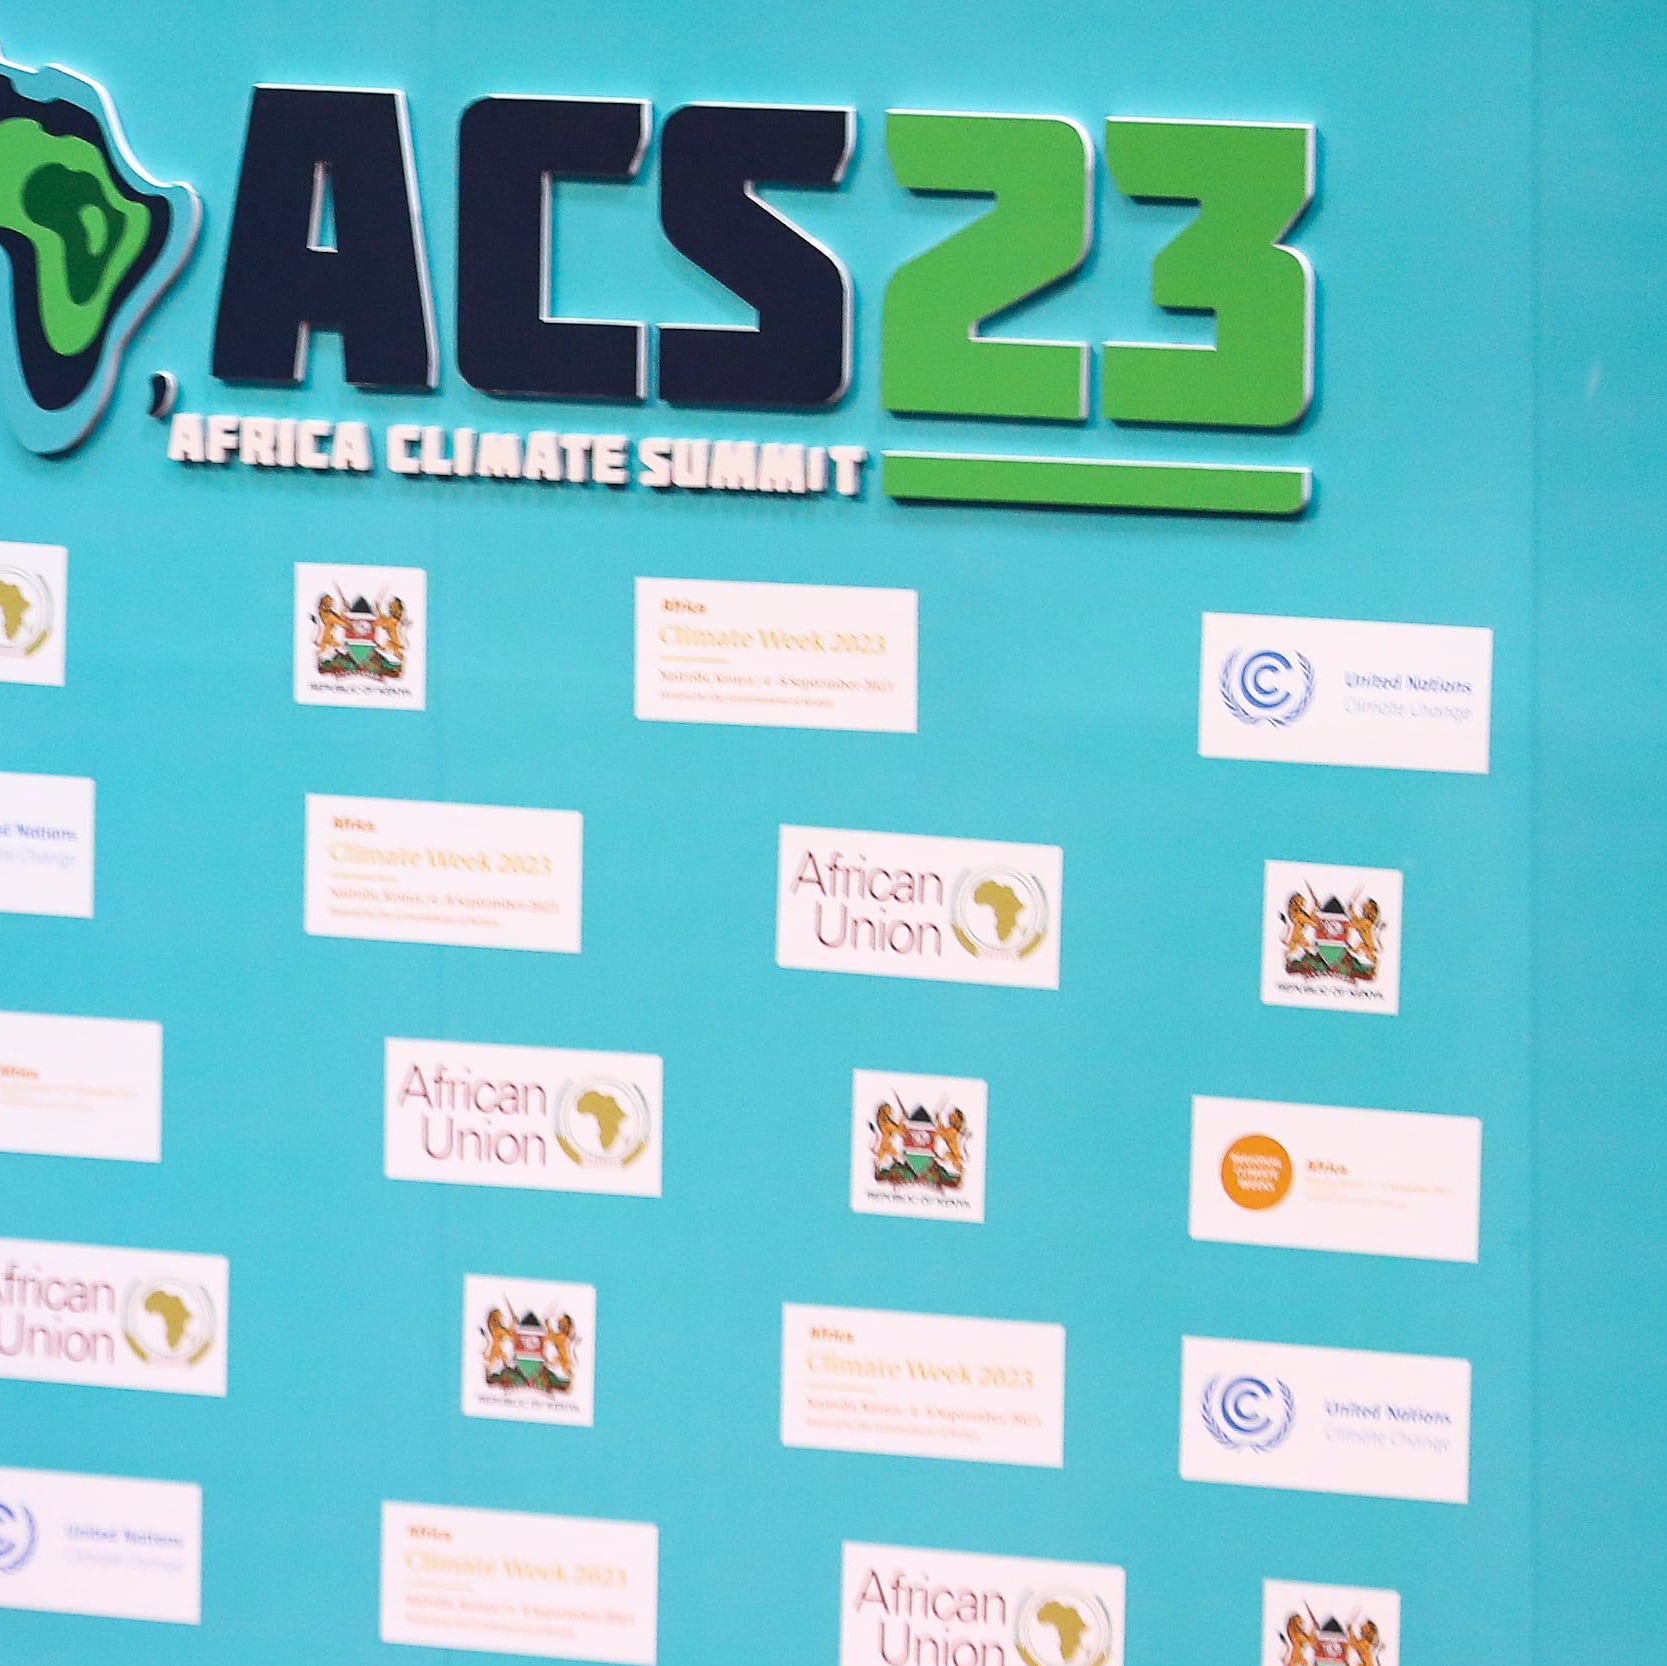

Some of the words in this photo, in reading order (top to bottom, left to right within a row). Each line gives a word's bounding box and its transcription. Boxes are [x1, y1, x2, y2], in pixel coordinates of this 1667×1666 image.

[212, 83, 1317, 427] ACS23
[168, 413, 371, 472] AFRICA
[384, 424, 631, 484] CLIMATE
[636, 437, 867, 495] SUMMIT
[790, 850, 944, 907] African
[815, 900, 942, 957] Union
[398, 1063, 547, 1117] African
[422, 1114, 547, 1168] Union
[855, 1569, 1007, 1627] African
